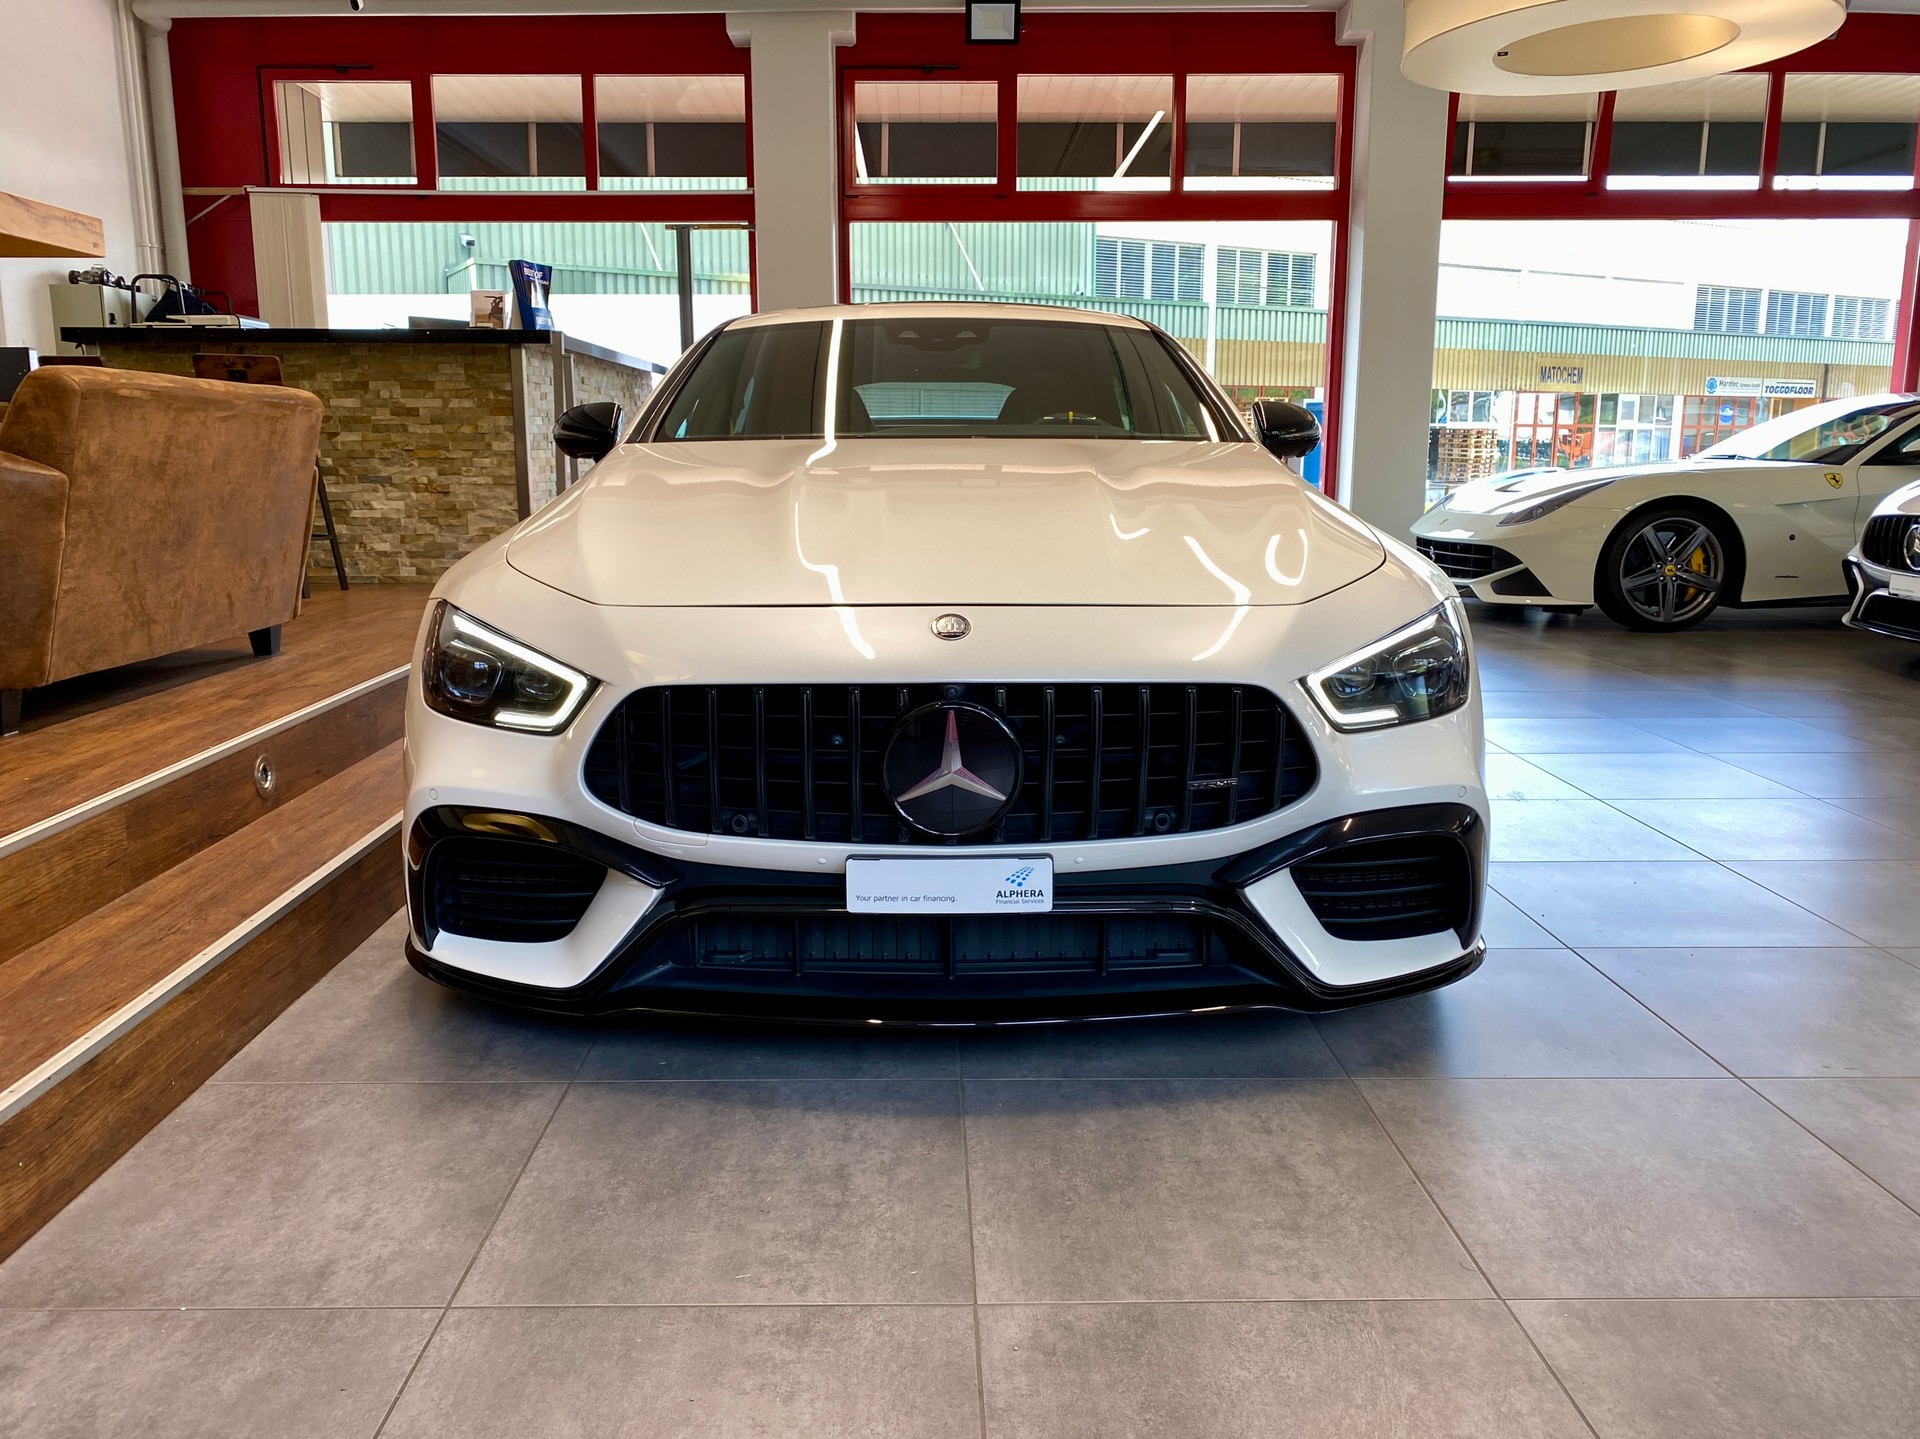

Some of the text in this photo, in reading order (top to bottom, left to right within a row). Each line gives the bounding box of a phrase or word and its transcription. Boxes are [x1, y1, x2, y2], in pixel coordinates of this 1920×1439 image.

[1540, 365, 1584, 384] MATOCHEM
[1764, 385, 1814, 395] TOGGOFLOOR
[996, 889, 1044, 898] ALPHERA
[855, 894, 872, 902] Your
[873, 895, 899, 904] partner
[901, 894, 908, 902] in
[922, 894, 958, 904] financing.
